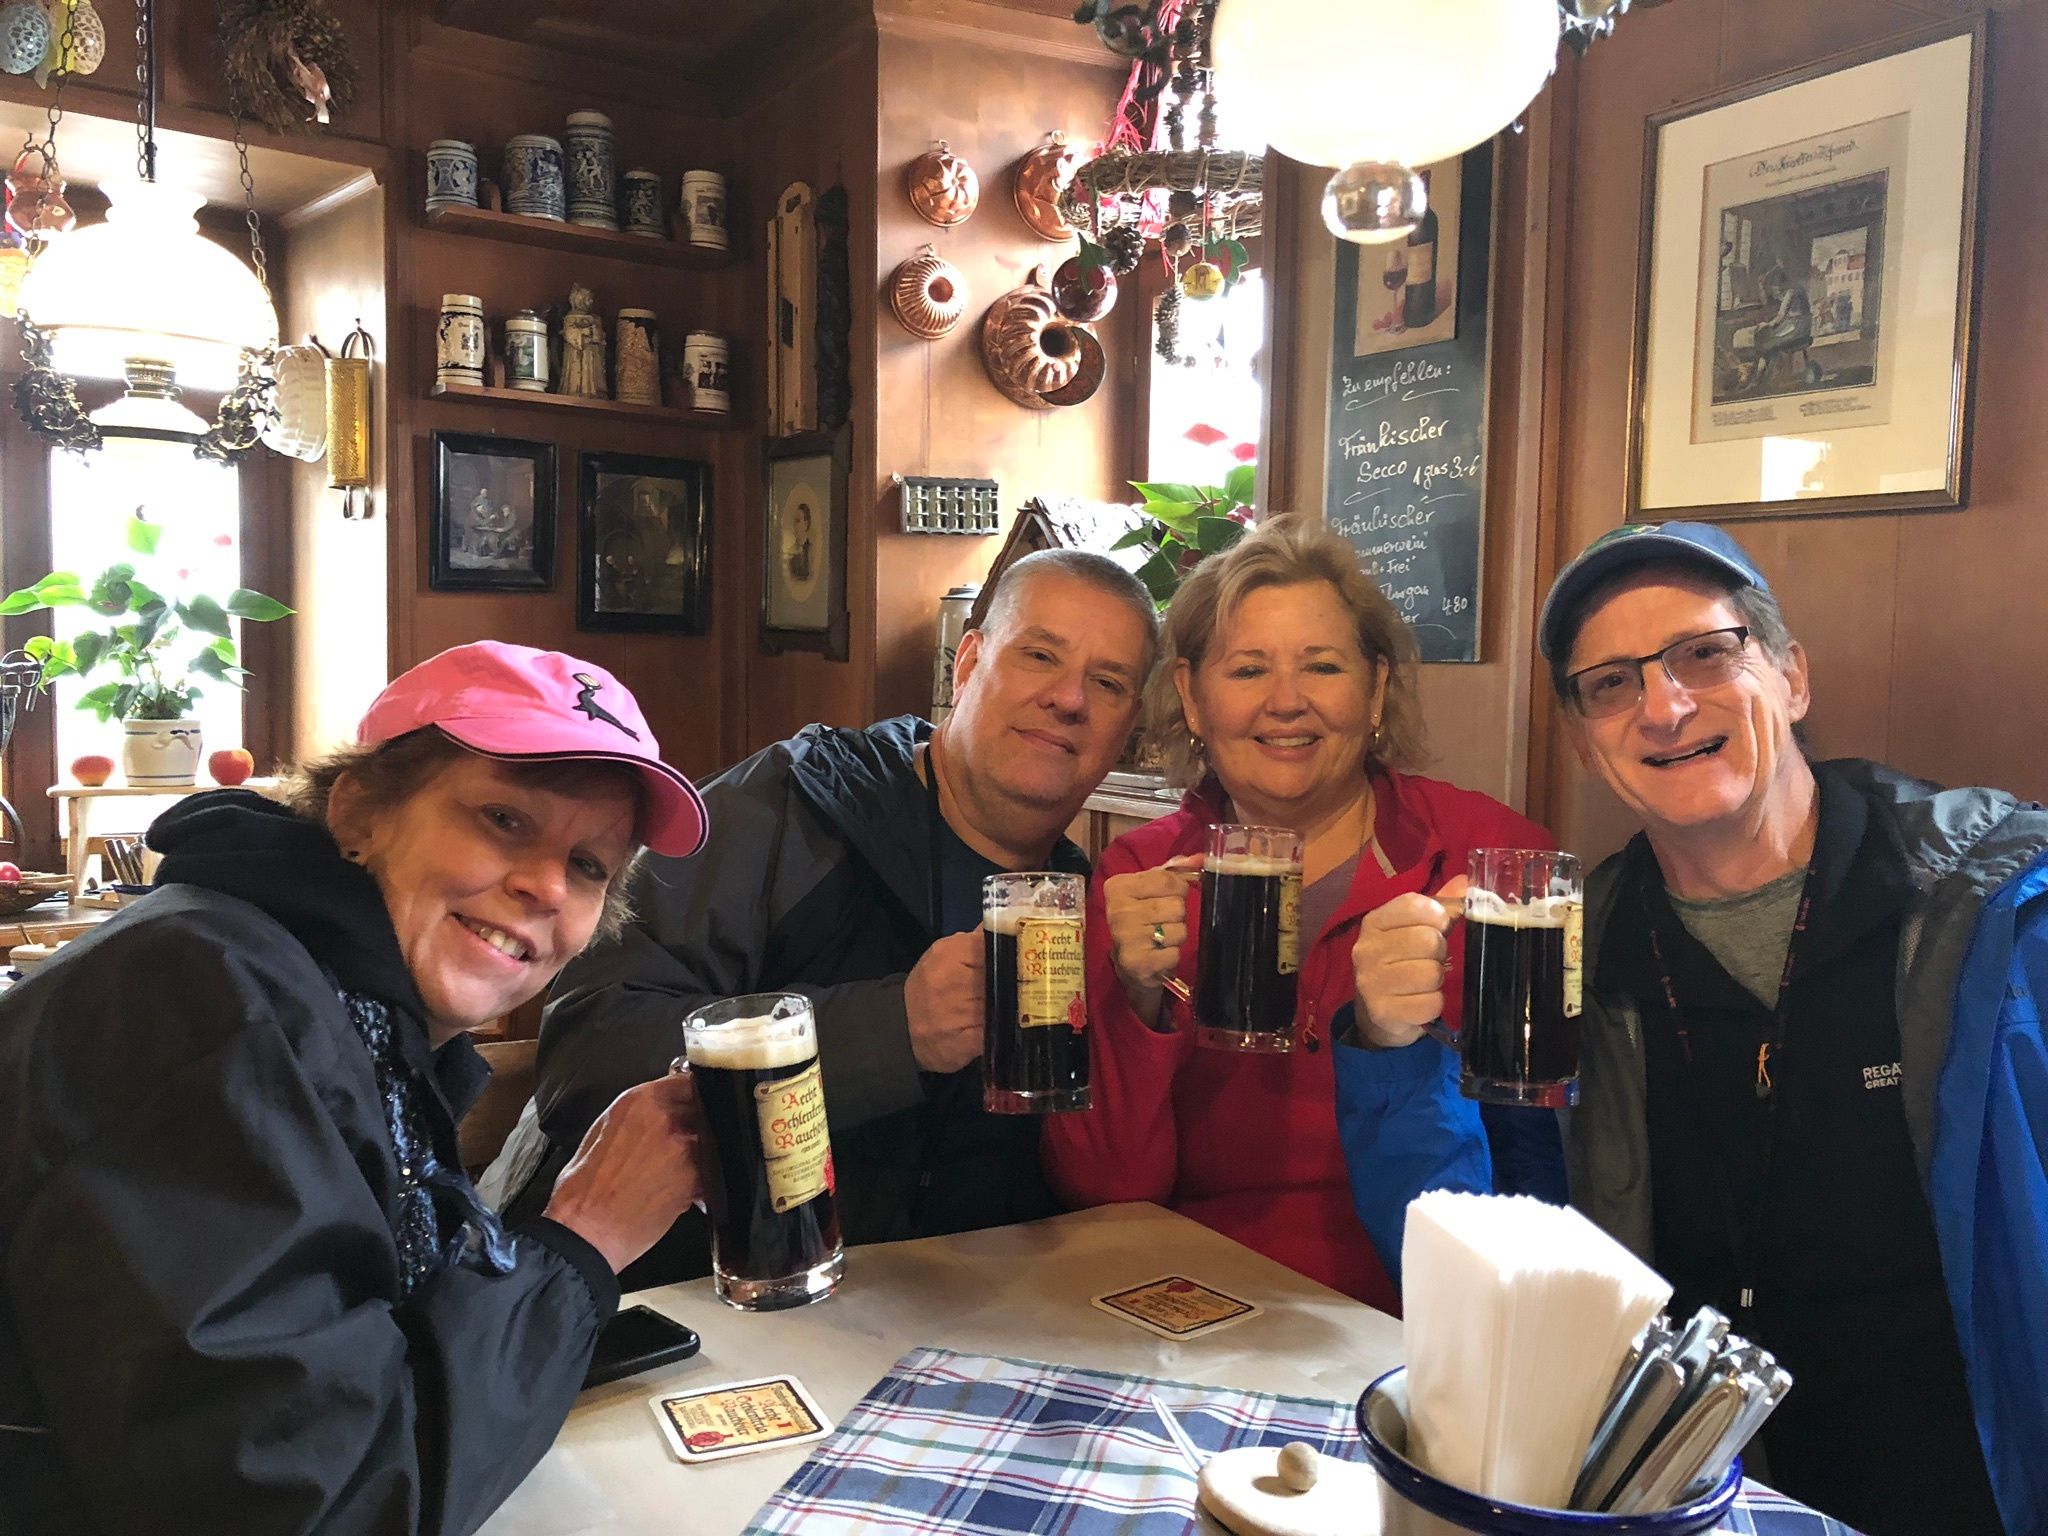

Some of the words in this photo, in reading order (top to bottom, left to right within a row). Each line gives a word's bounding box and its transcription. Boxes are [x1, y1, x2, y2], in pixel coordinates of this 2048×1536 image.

[1338, 416, 1450, 460] Fränkischer
[1357, 460, 1408, 483] Secco
[1862, 1062, 1903, 1081] REGA
[1865, 1077, 1899, 1090] GREAT
